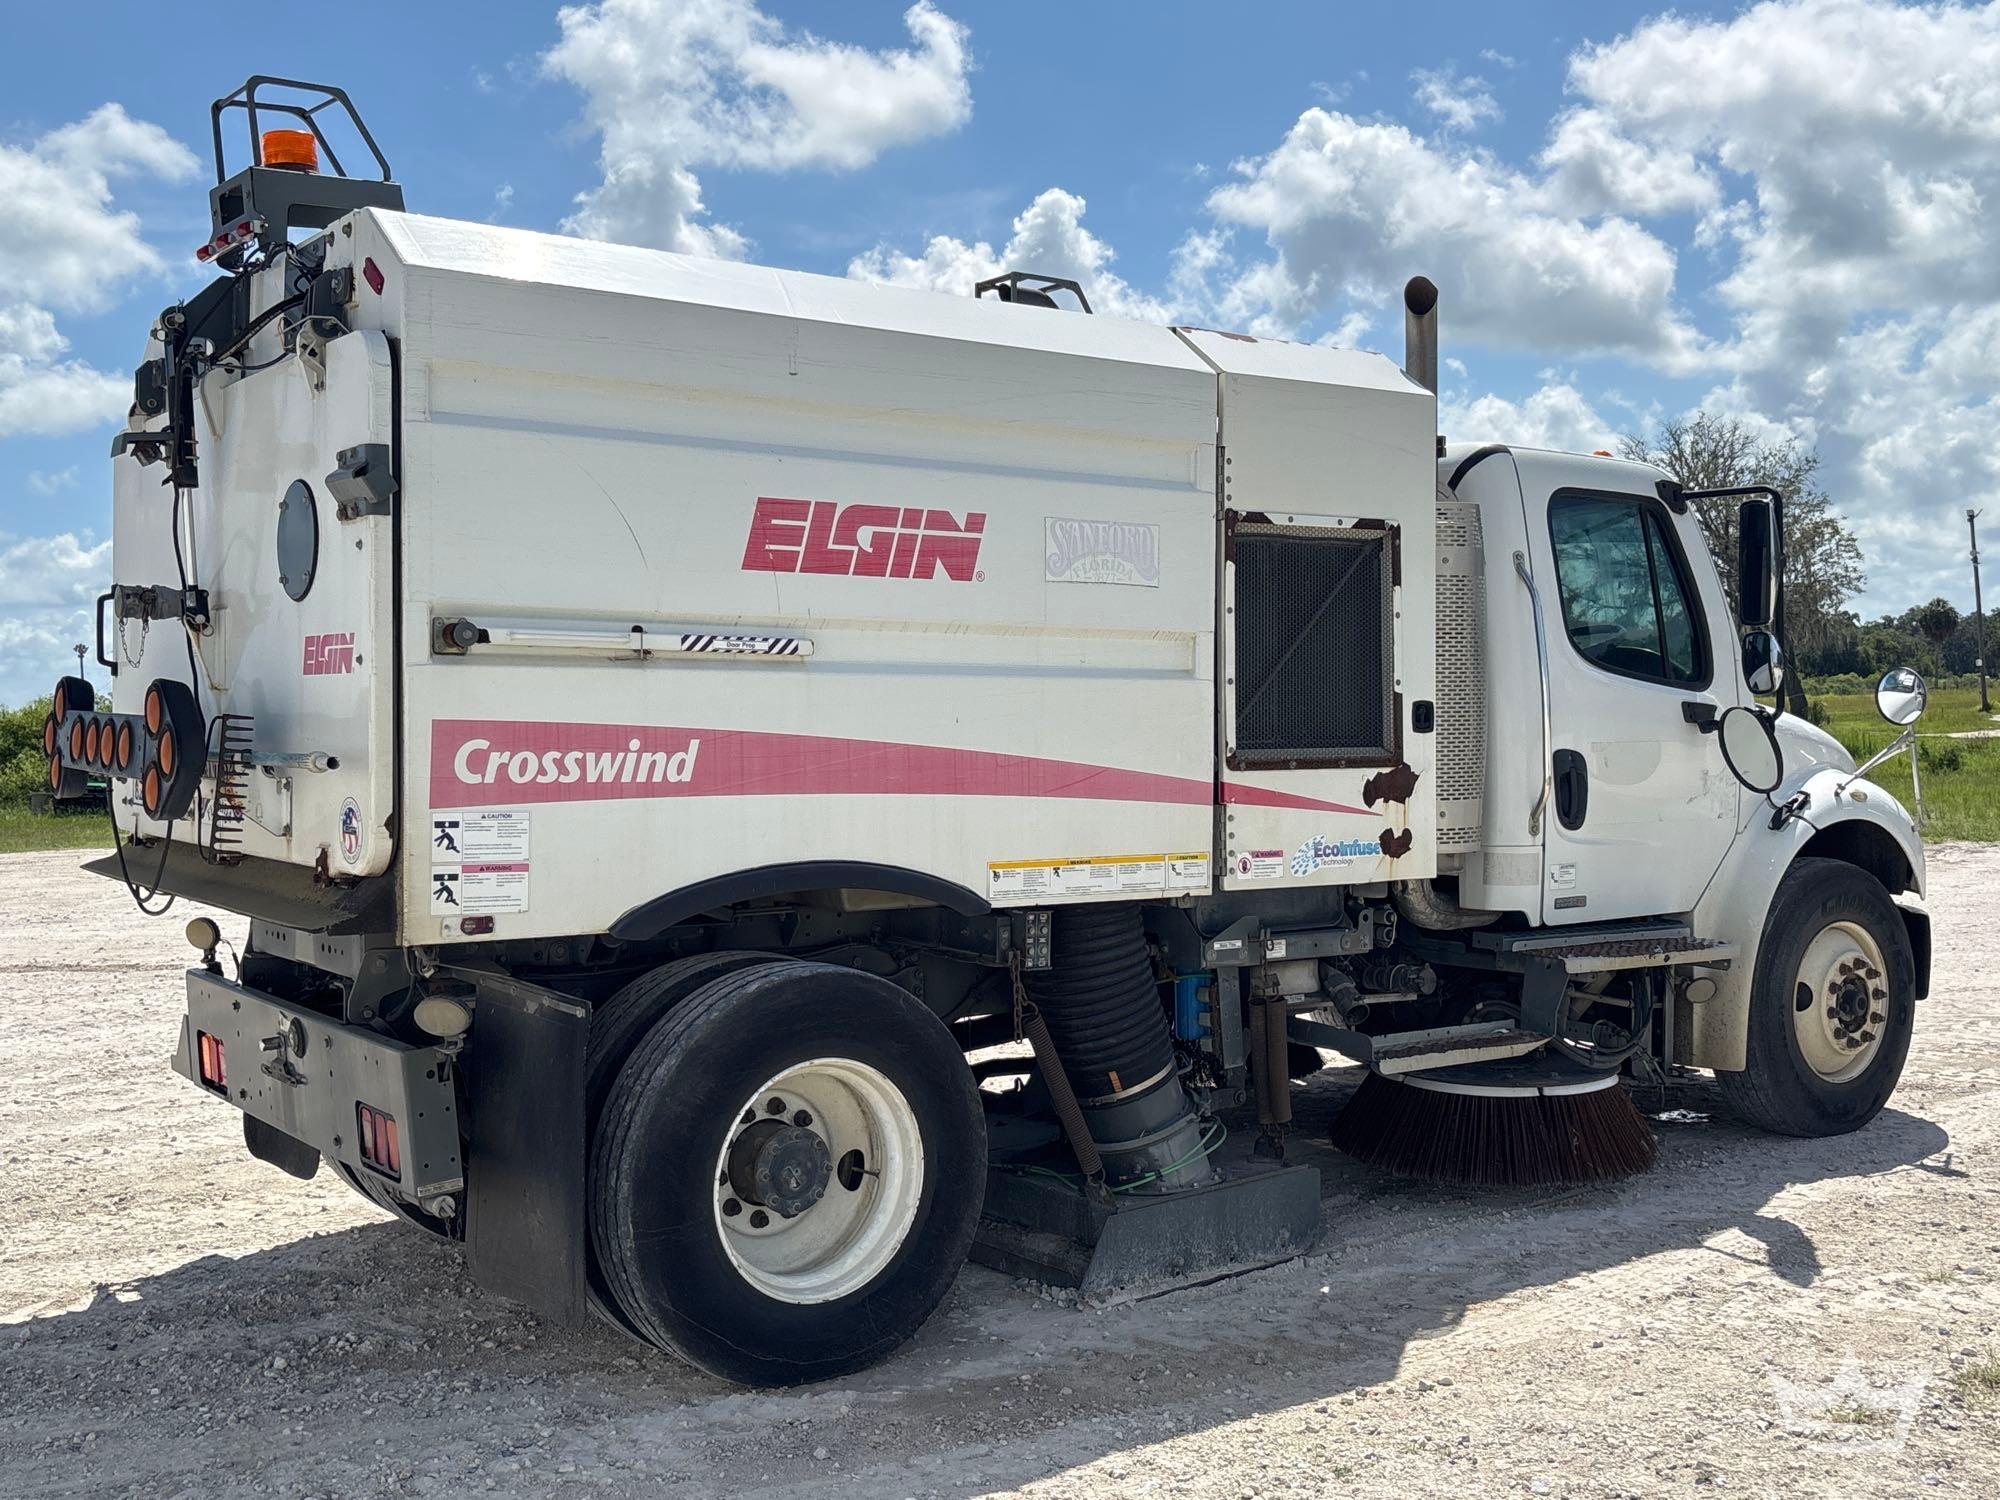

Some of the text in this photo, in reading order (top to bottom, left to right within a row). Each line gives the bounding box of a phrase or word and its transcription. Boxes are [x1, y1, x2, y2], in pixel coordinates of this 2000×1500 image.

[741, 496, 987, 582] ELGIN
[1046, 519, 1157, 582] SANFORD
[1073, 558, 1134, 582] FLORIDA
[303, 632, 355, 676] ELGIN
[742, 641, 756, 649] Prop
[454, 738, 701, 784] Crosswind
[1320, 858, 1354, 866] Technology
